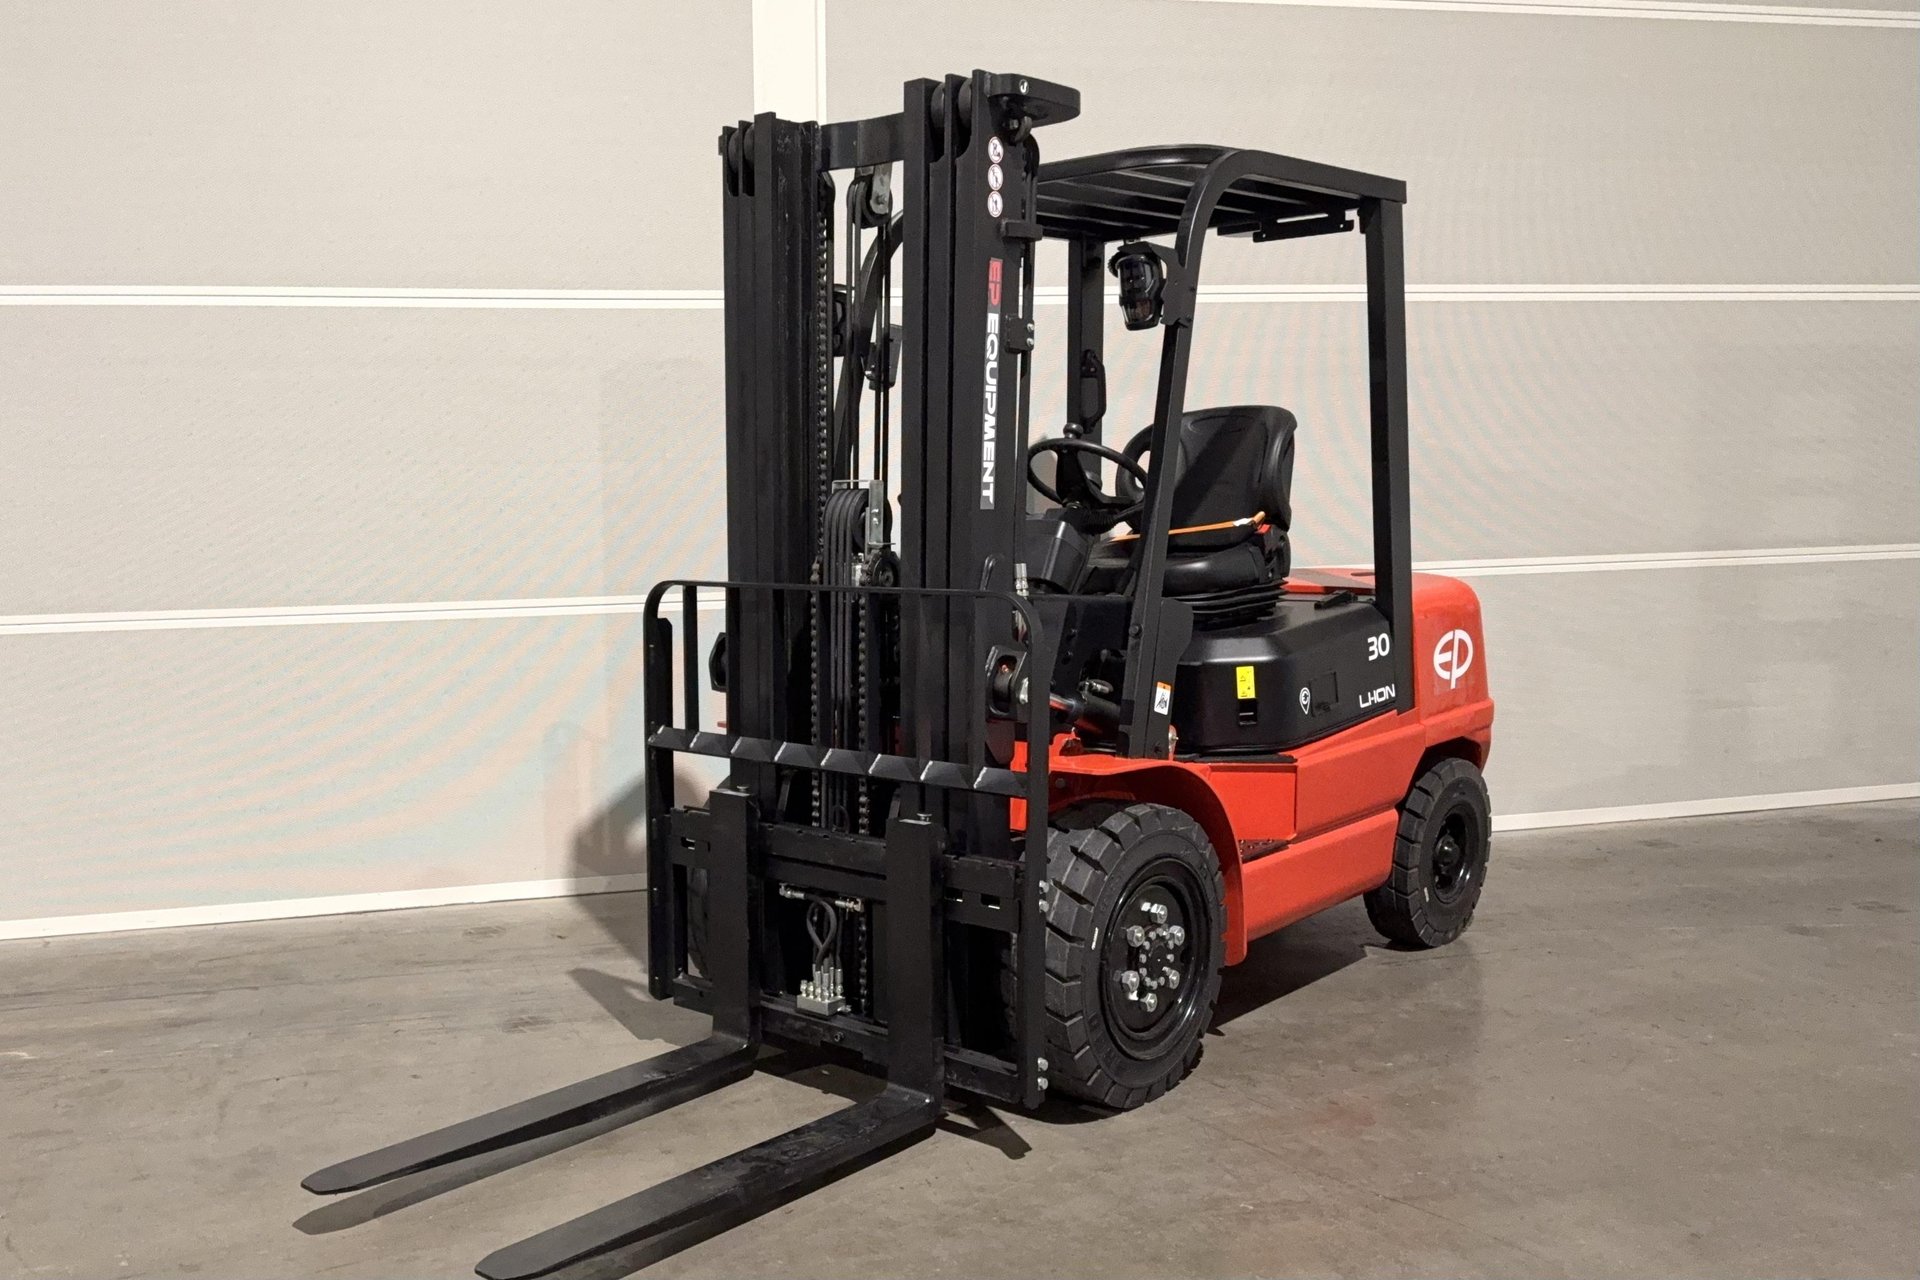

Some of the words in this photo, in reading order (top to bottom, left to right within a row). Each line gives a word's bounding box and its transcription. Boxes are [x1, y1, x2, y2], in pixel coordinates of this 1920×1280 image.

[989, 260, 1001, 306] EP
[982, 312, 999, 504] EQUIPMENT
[1367, 632, 1391, 661] 30
[1433, 628, 1474, 690] EP
